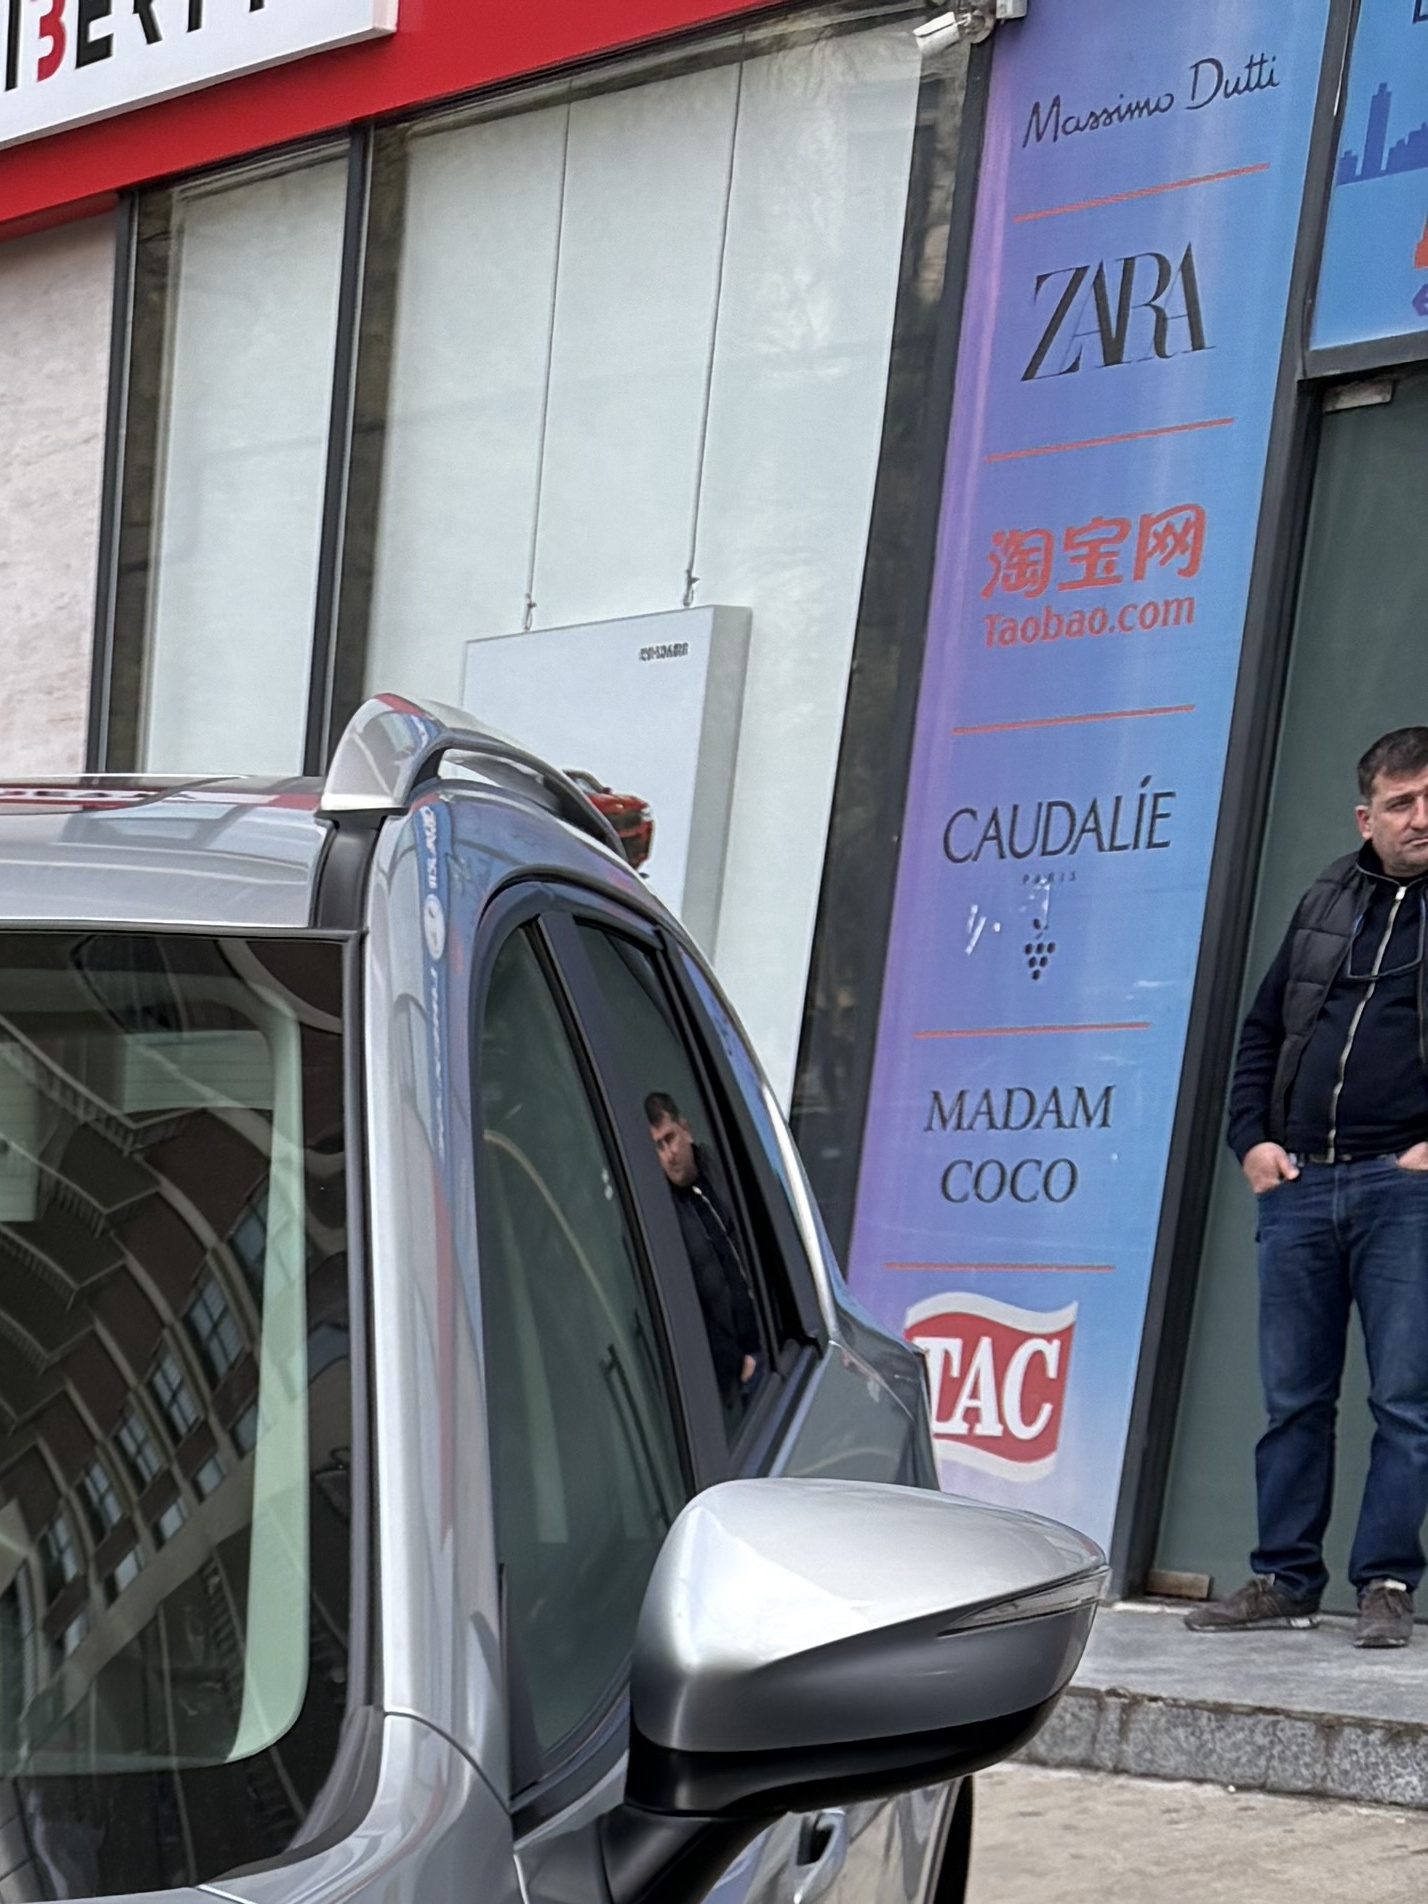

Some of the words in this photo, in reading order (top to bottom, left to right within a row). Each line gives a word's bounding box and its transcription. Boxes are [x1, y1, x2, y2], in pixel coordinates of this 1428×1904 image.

[1022, 93, 1175, 149] Massimo
[1185, 52, 1280, 110] Dutti
[1020, 241, 1216, 382] ZARA
[980, 503, 1206, 600] 淘宝网
[983, 596, 1195, 649] Taobao.com
[943, 775, 1176, 864] CAUDALÍE
[924, 1085, 1115, 1133] MADAM
[941, 1158, 1078, 1203] COCO
[912, 1336, 1061, 1441] TAC
